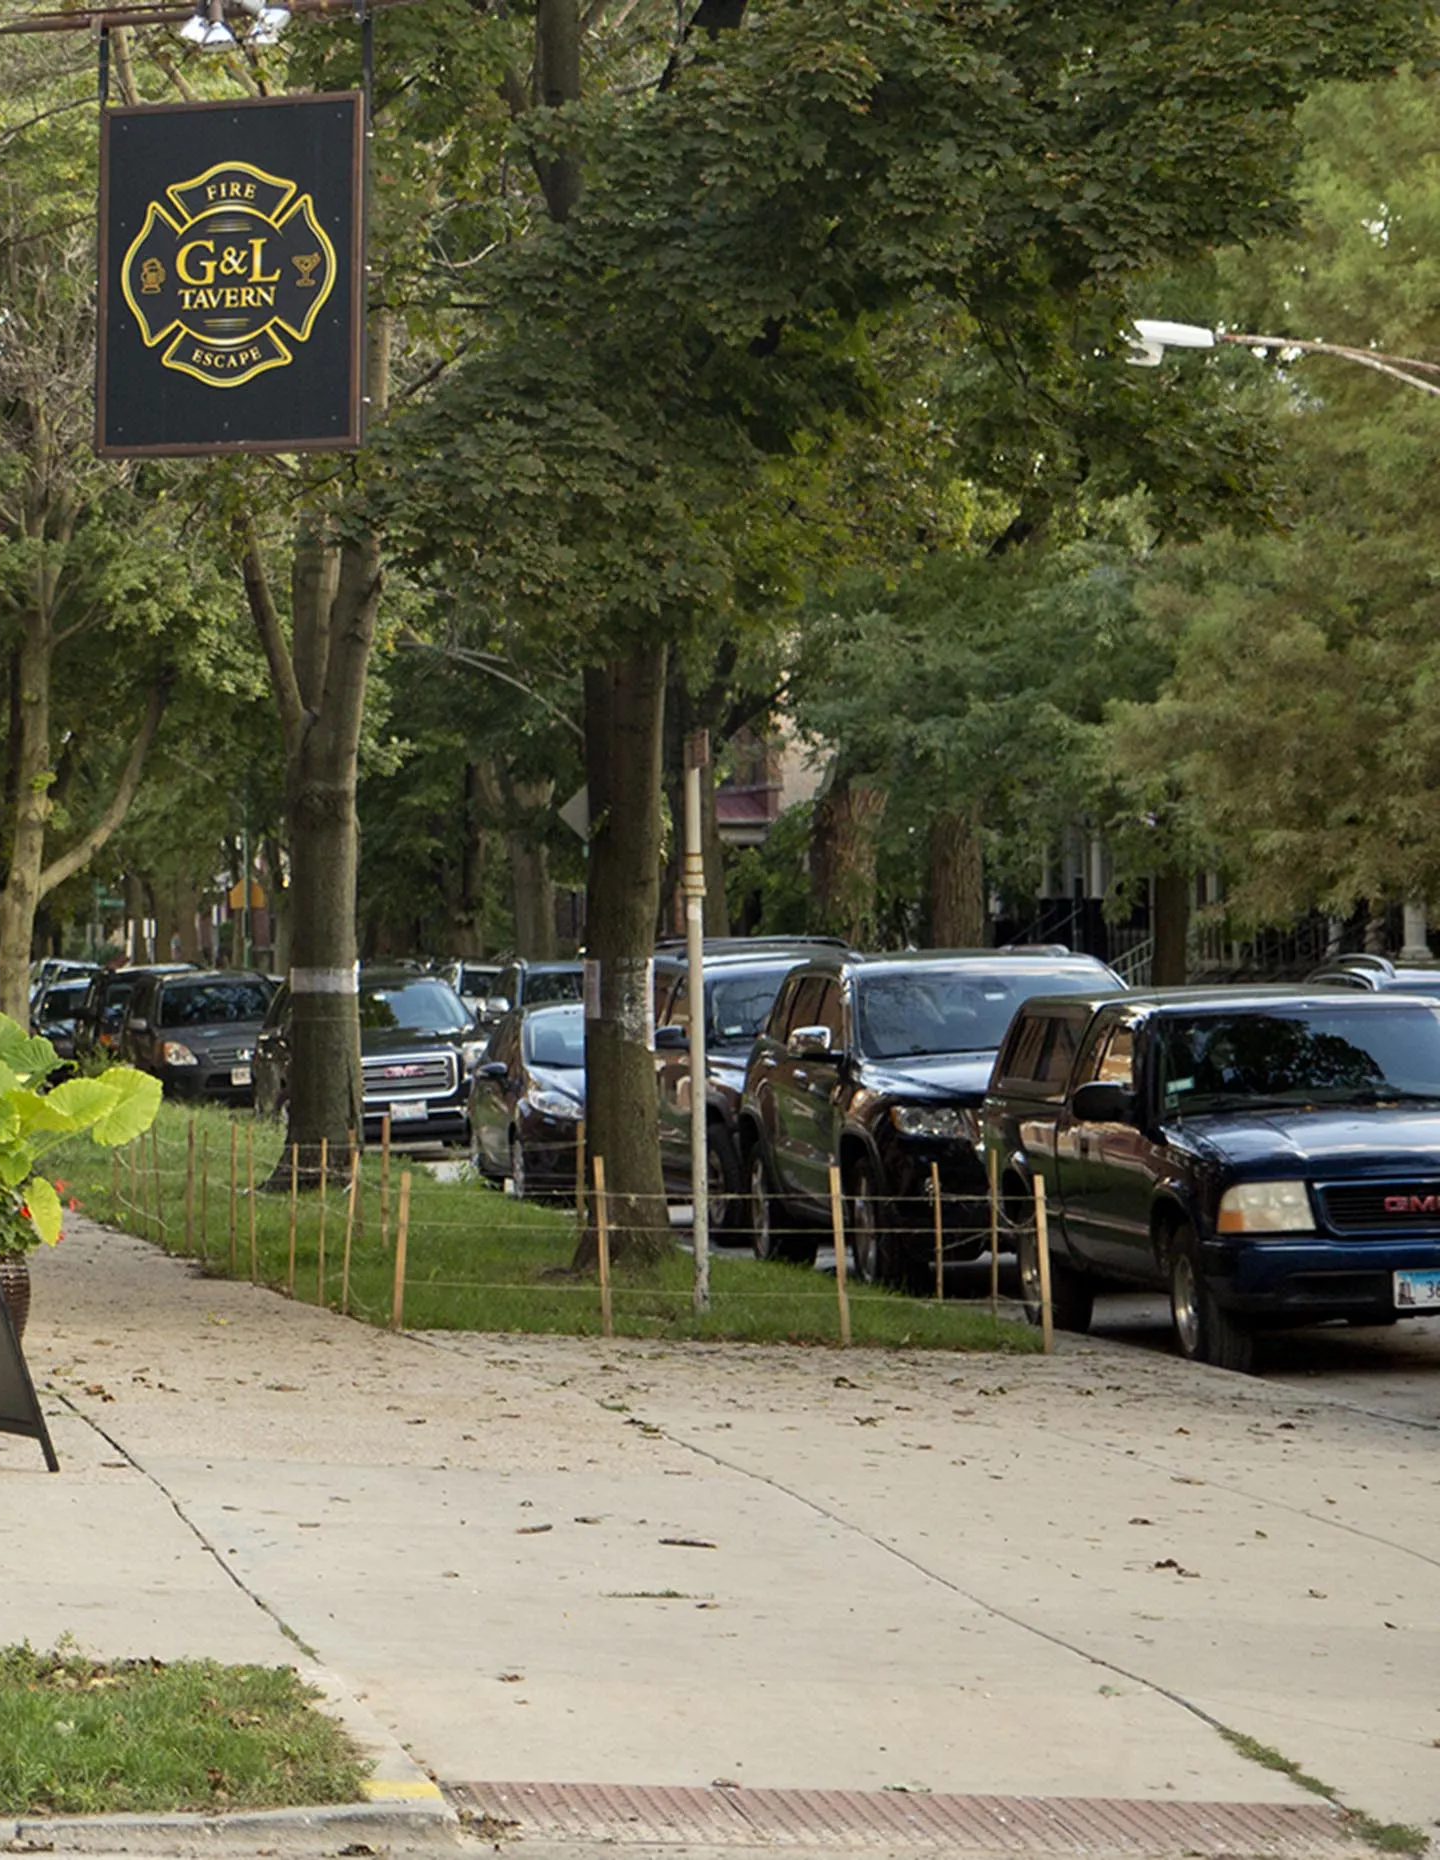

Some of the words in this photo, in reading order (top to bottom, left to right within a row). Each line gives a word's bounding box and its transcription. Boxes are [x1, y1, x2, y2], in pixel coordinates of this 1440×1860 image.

[205, 182, 258, 200] FIRE
[175, 237, 281, 285] G&L
[177, 286, 276, 310] TAVERN
[191, 347, 262, 368] ESCAPE
[1383, 1195, 1440, 1213] GM
